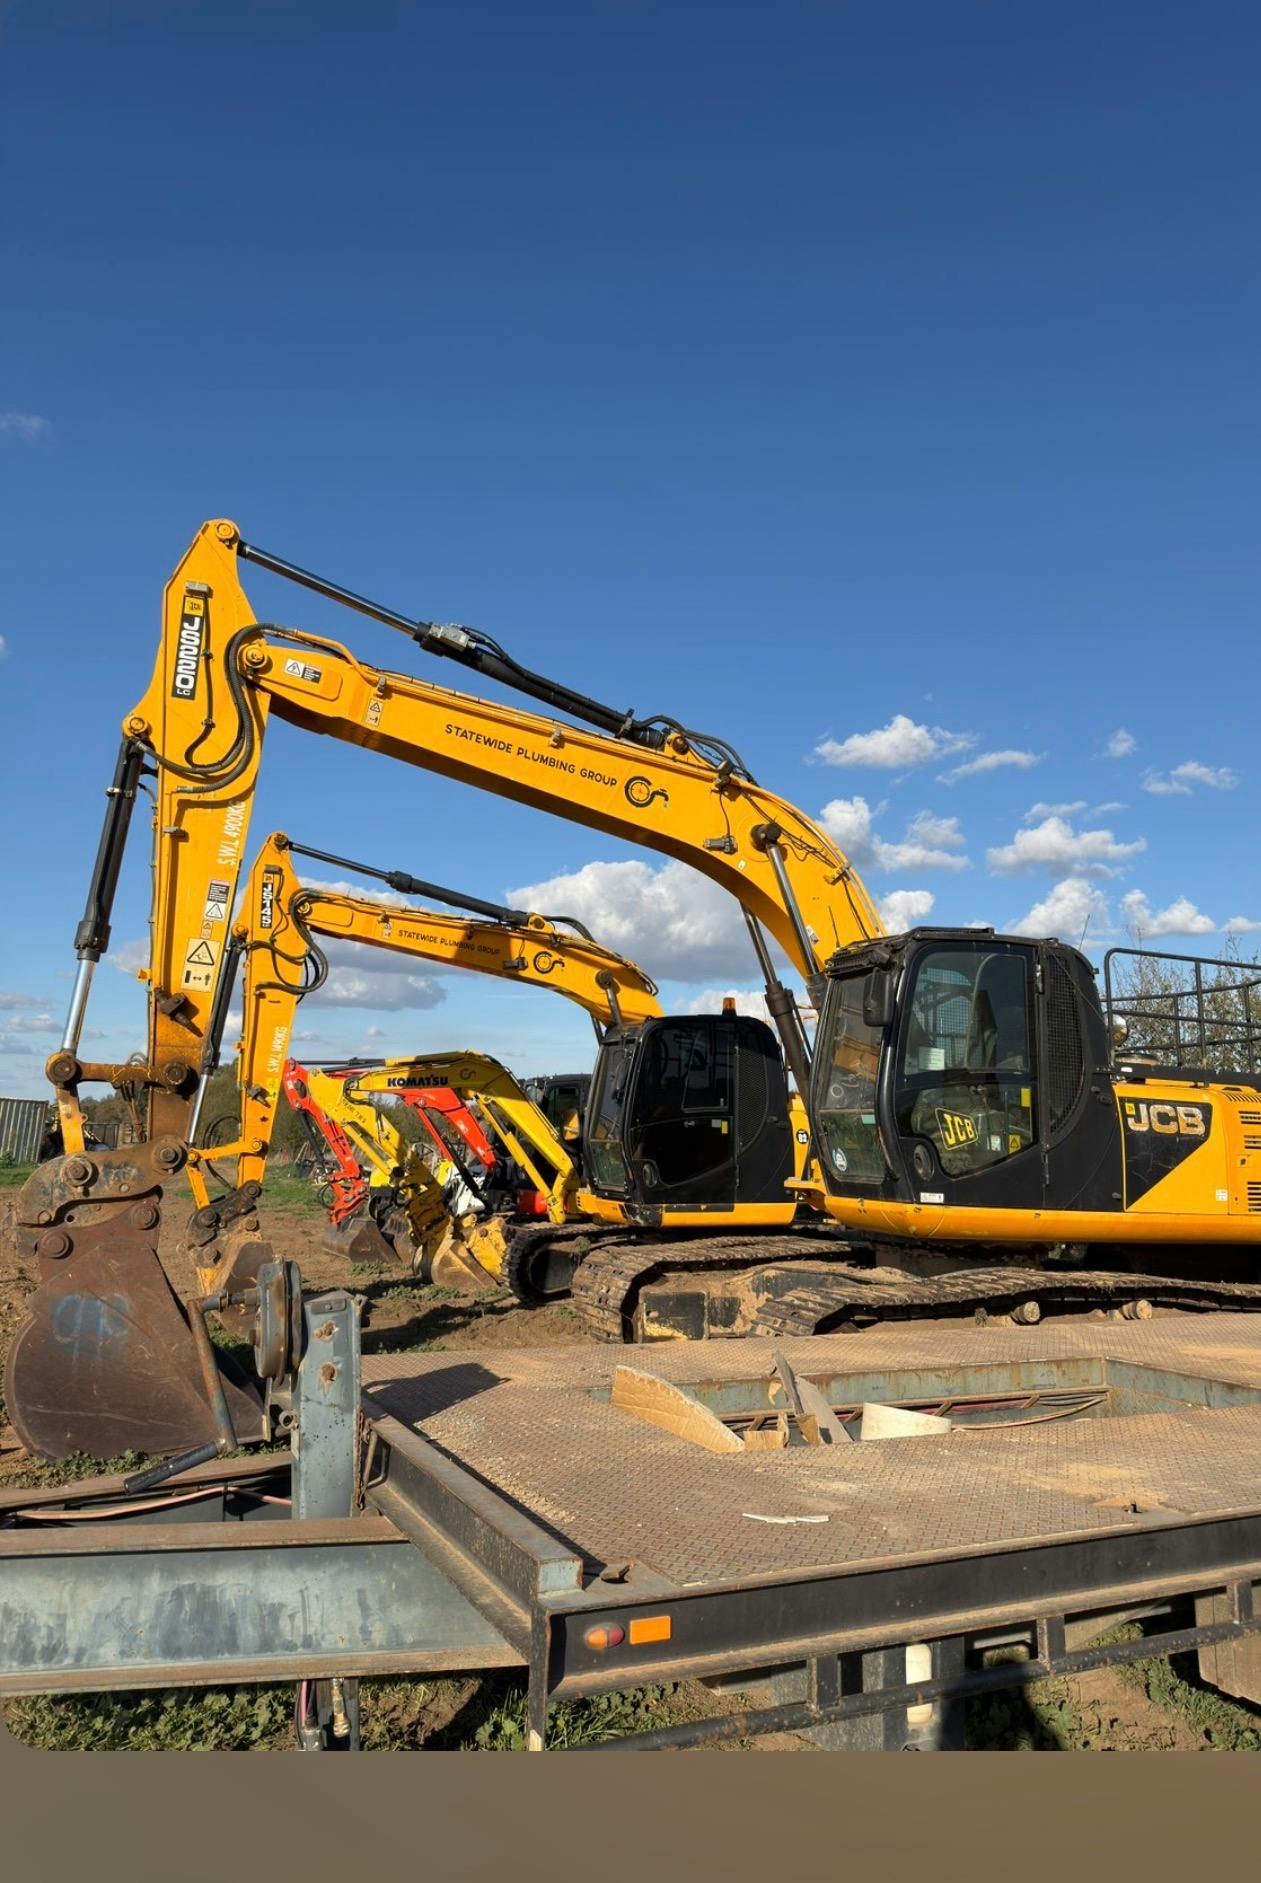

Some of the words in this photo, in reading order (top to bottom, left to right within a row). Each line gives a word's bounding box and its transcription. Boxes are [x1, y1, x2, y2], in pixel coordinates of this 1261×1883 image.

[175, 617, 200, 690] JS220
[445, 723, 512, 753] STATEWIDE
[516, 746, 576, 774] PLUMBING
[580, 767, 618, 788] GROUP
[261, 883, 273, 924] JS145
[398, 929, 438, 944] STATEWIDE
[439, 937, 476, 951] PLUMBING
[477, 945, 500, 956] GROUP
[387, 1074, 449, 1087] KOMATSU
[943, 1113, 975, 1145] JCB
[1125, 1103, 1206, 1135] JCB
